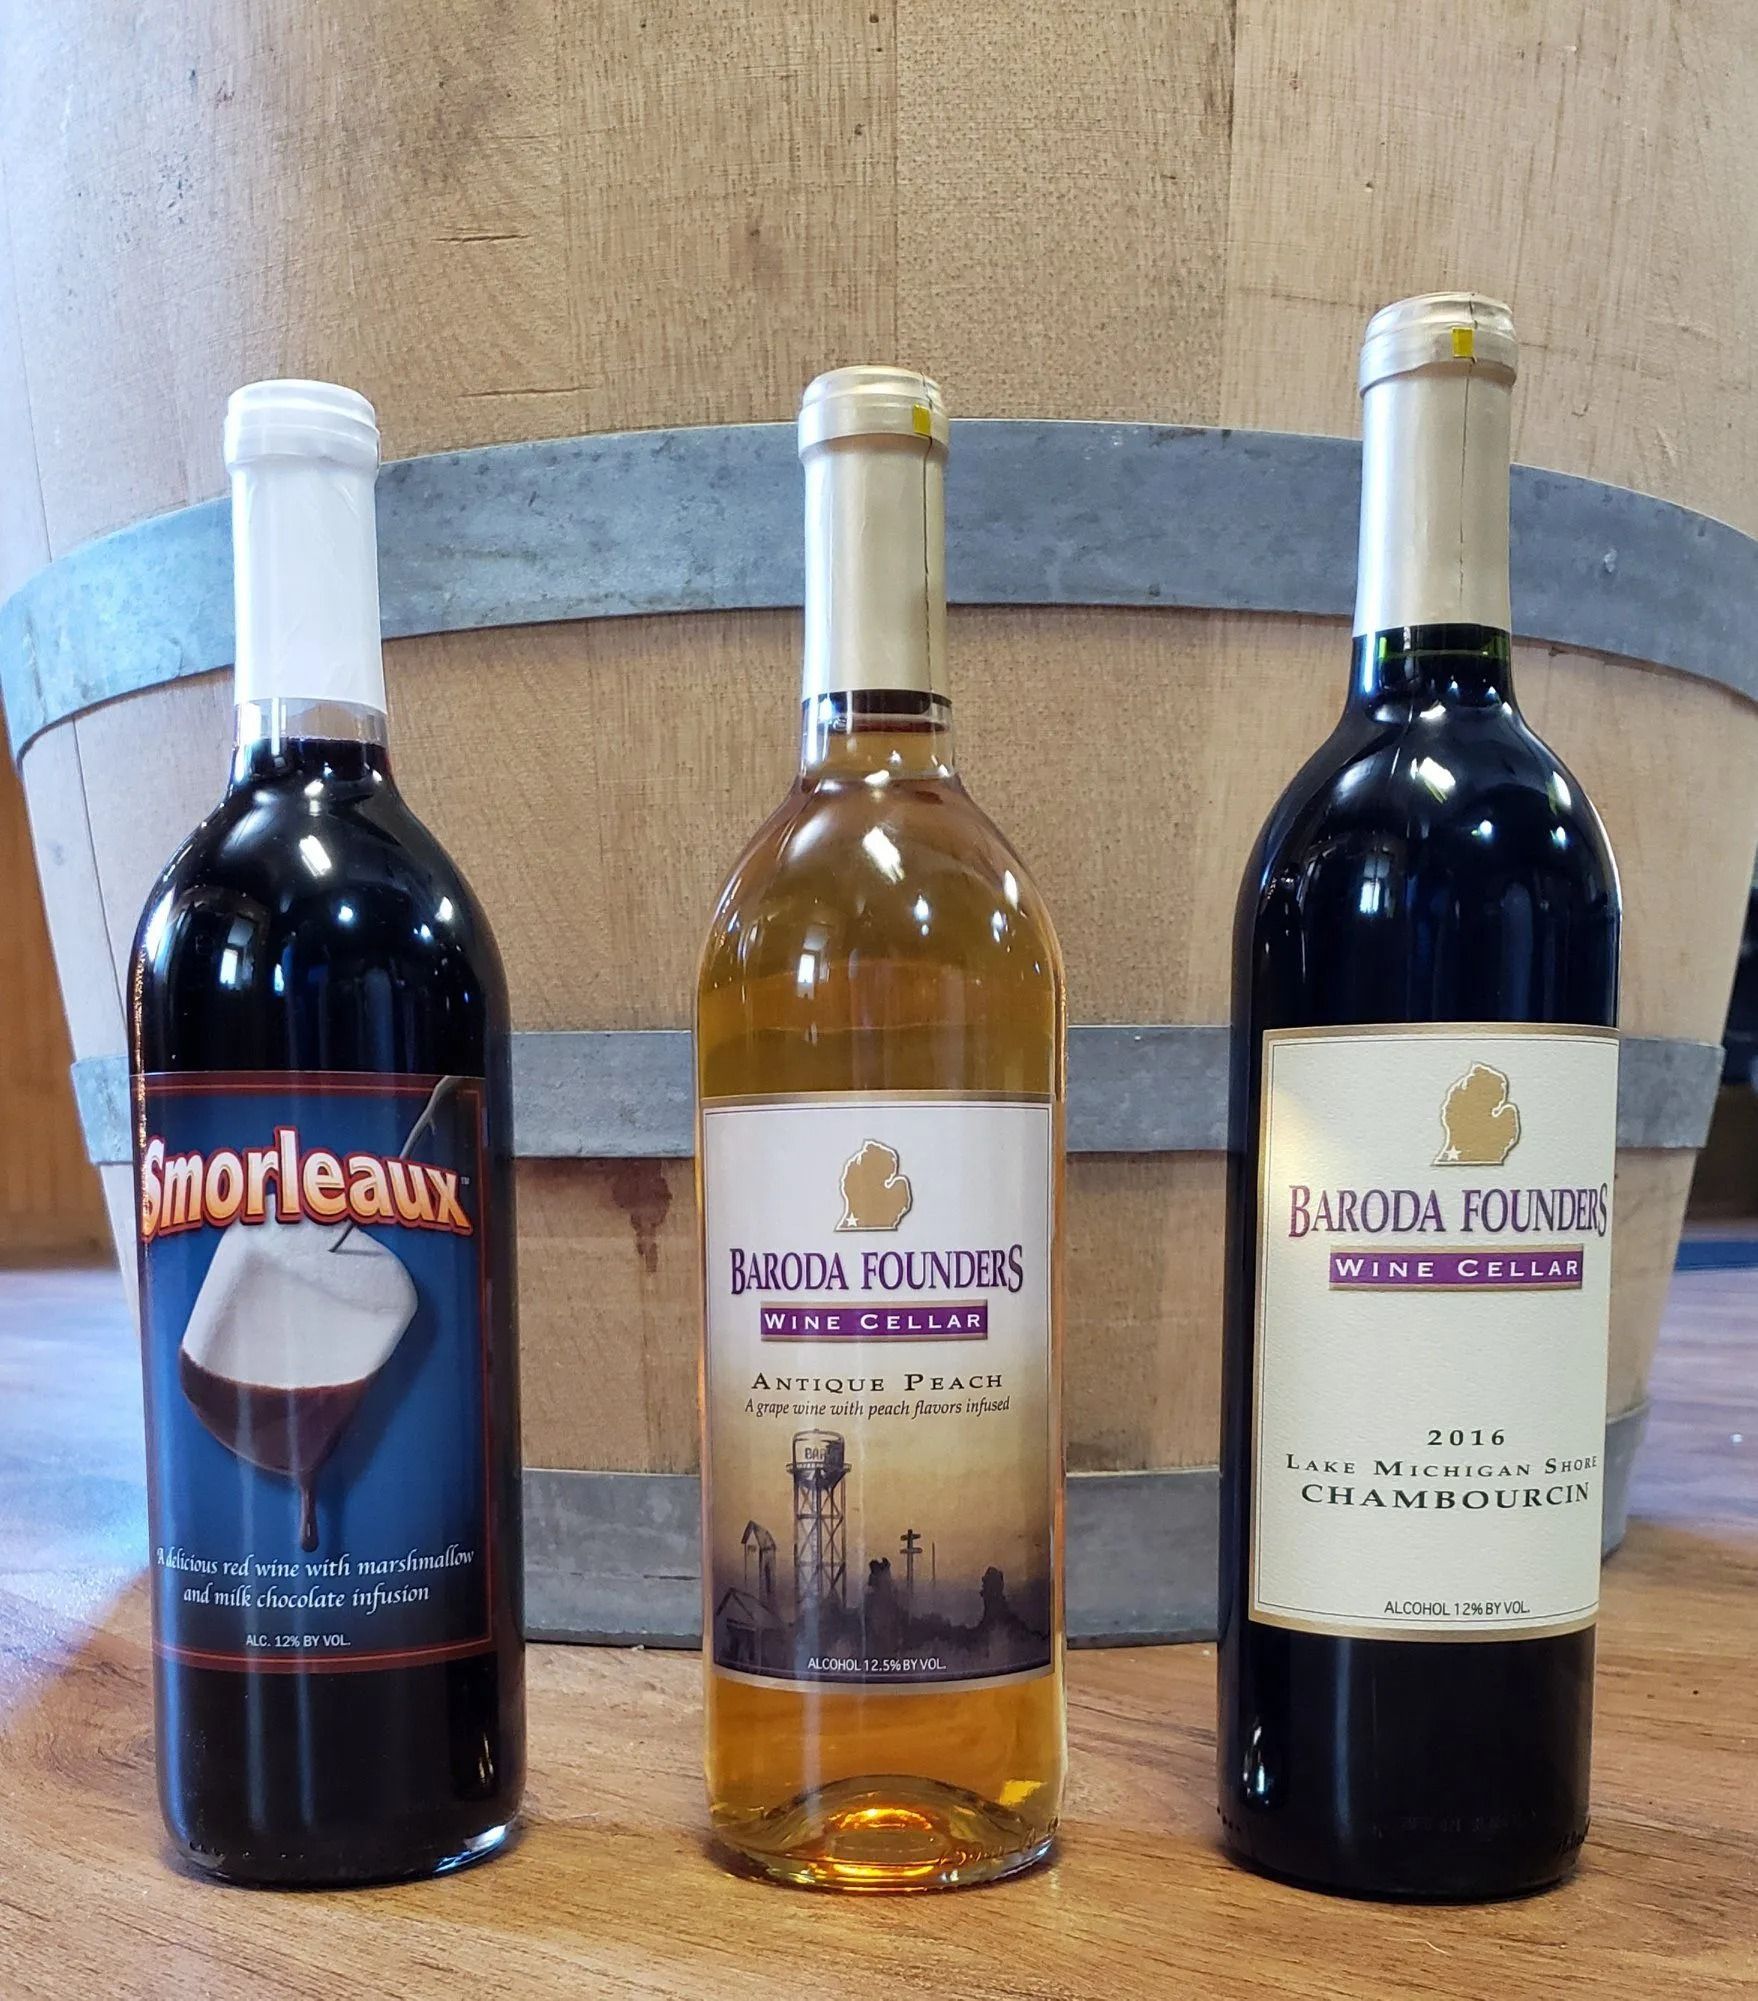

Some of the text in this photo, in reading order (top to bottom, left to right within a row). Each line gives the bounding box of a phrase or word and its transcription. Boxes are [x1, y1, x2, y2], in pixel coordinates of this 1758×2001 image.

[141, 1126, 473, 1241] Smorleaux
[1288, 1182, 1608, 1238] BARODA FOUNDERS
[730, 1244, 1024, 1295] BARODA FOUNDERS
[1335, 1258, 1579, 1277] WINE CELLAR
[764, 1313, 981, 1331] WINE CELLAR
[751, 1373, 1003, 1394] ANTIQUE PEACH
[745, 1396, 1010, 1420] A grape wine with peach flavors infused
[1427, 1429, 1505, 1446] 2016
[1286, 1453, 1598, 1478] LAKE MICHIGAN SHORE
[1301, 1482, 1590, 1509] CHAMBOURCIN
[157, 1544, 475, 1577] A delicious red wine with marshmallow
[183, 1581, 430, 1616] and milk chocolate infusion
[1384, 1600, 1531, 1616] ALCOHOL 12% BY VOL.
[246, 1634, 352, 1648] ALC. 12% BY VOL.
[807, 1657, 947, 1671] ALCOHOL 12.5% BY VOL.
